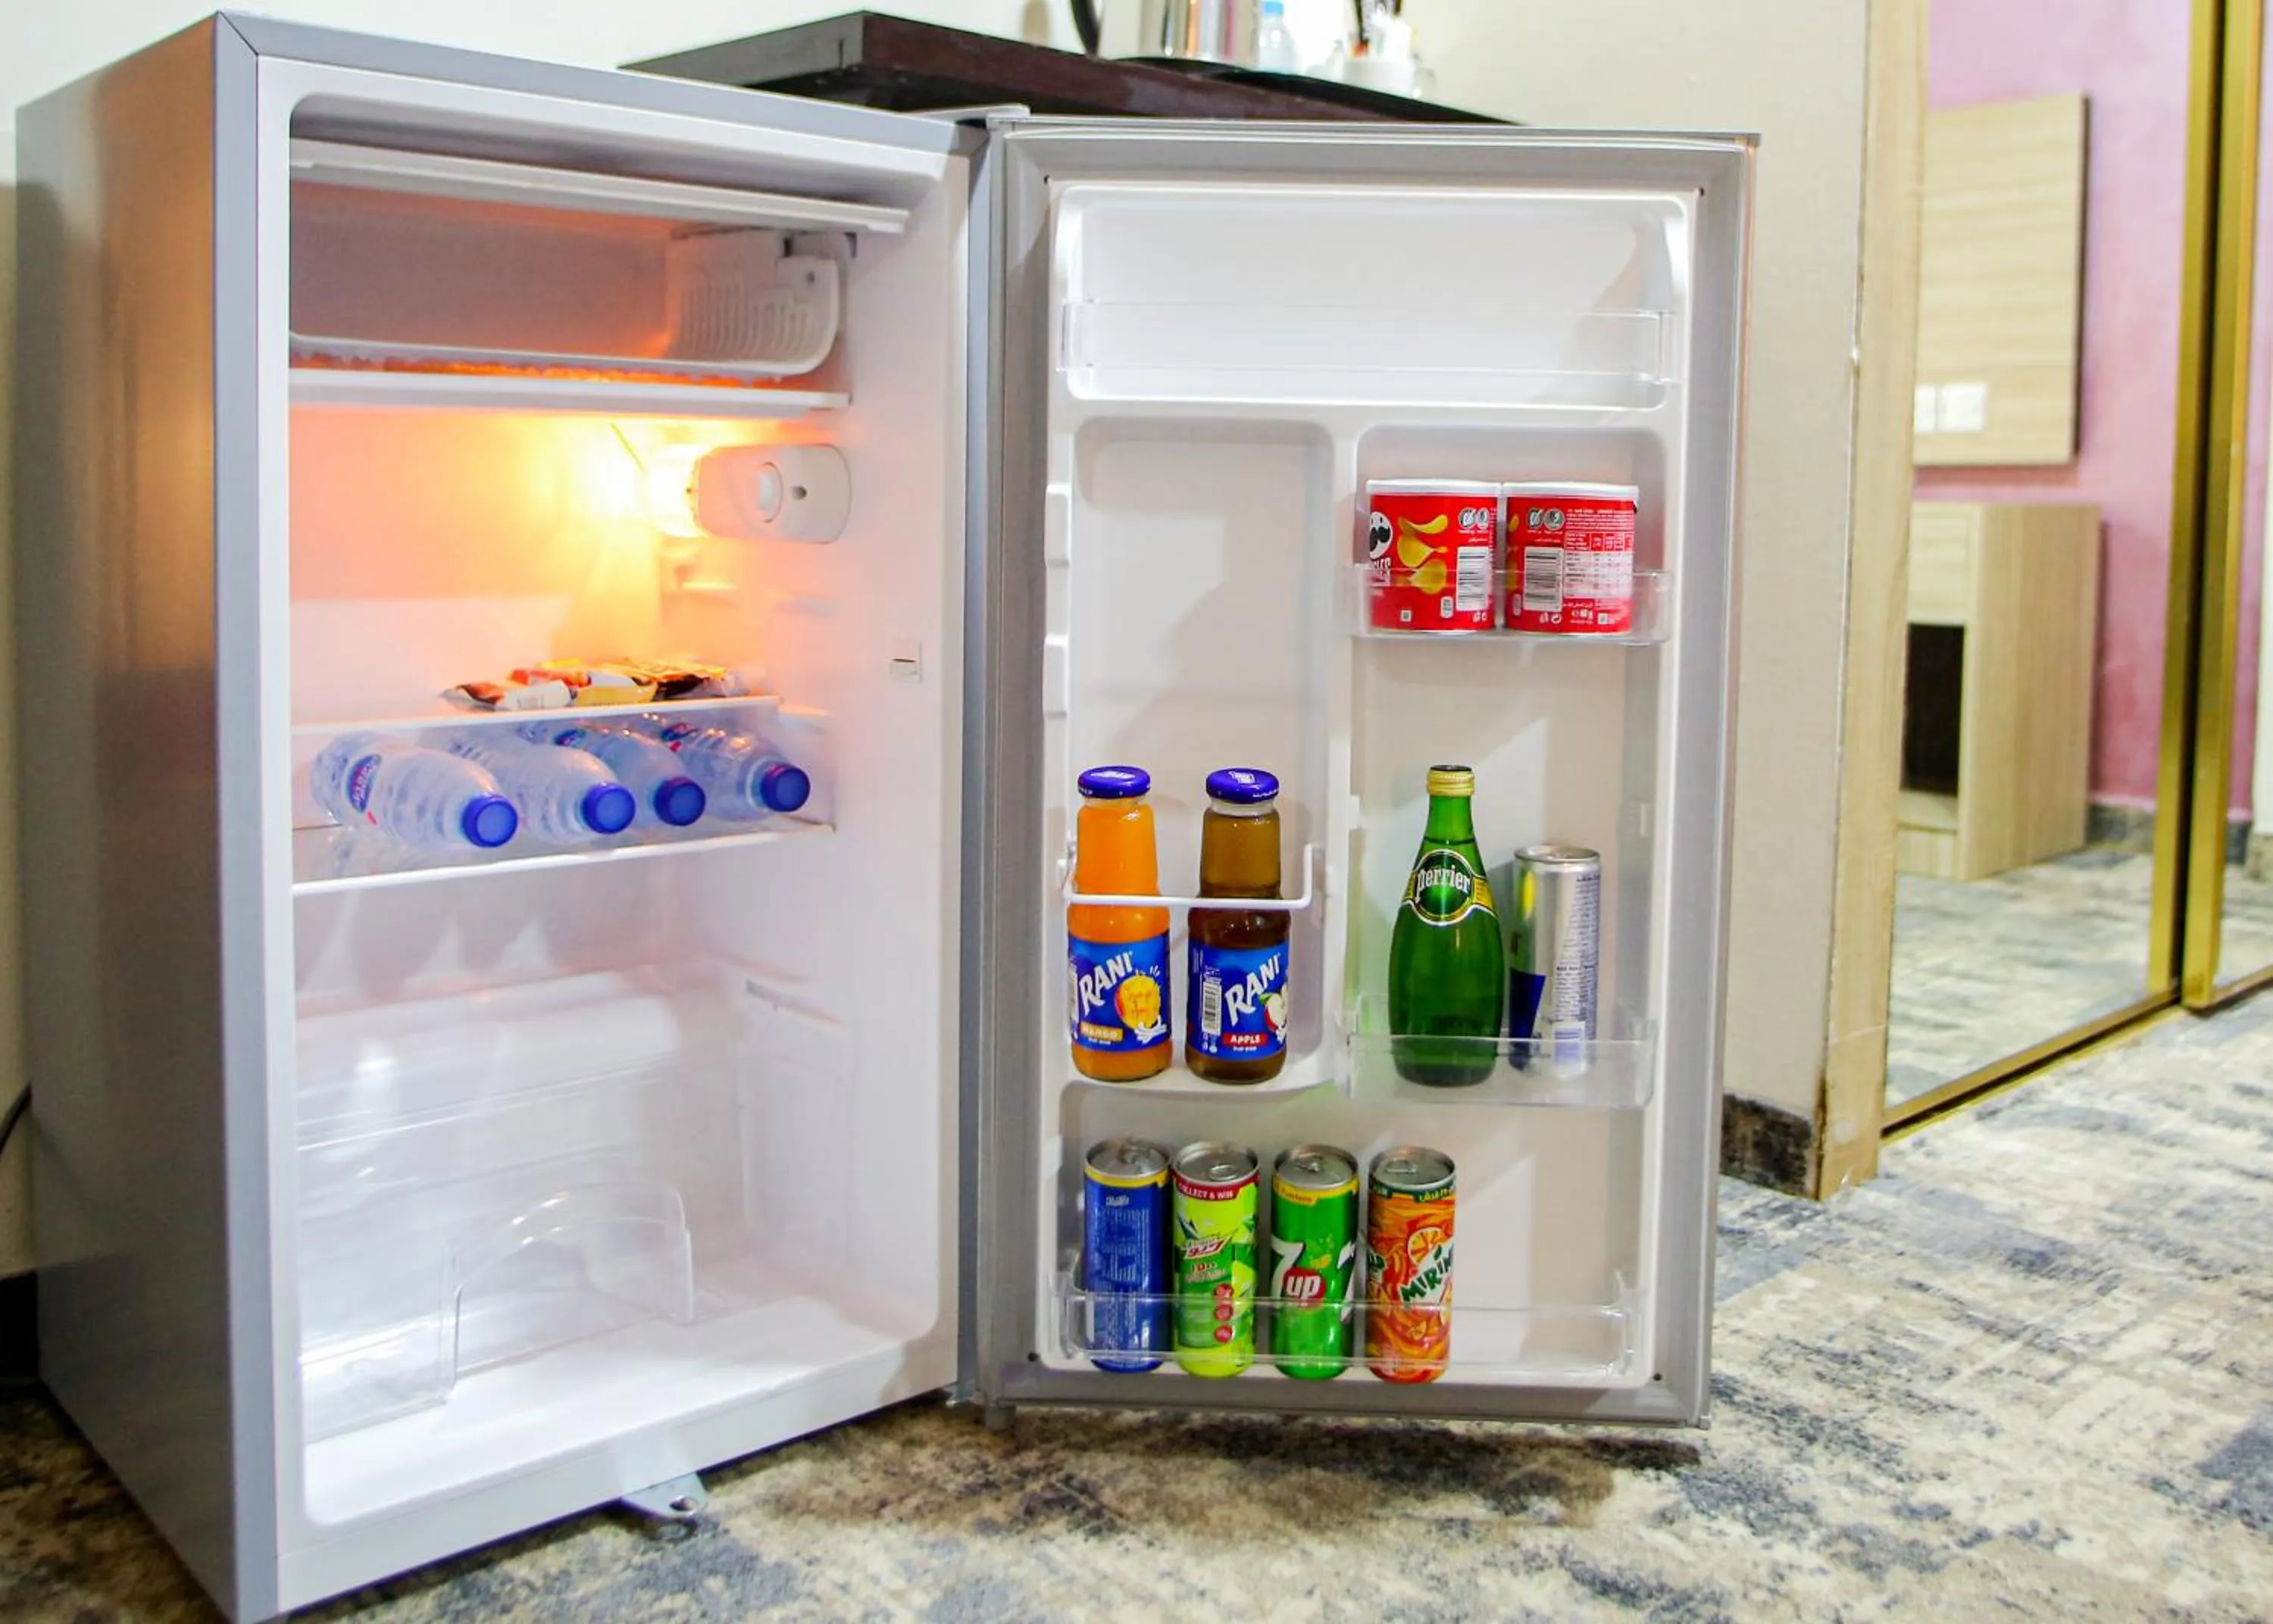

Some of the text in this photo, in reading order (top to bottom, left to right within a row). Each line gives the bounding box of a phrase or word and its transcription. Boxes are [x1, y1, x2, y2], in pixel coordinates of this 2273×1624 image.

[1079, 951, 1133, 1018] RANI
[1225, 954, 1280, 1026] RANI
[1230, 1034, 1261, 1045] APPLE
[1217, 1190, 1233, 1199] WIN
[1400, 1242, 1453, 1309] MIRIN
